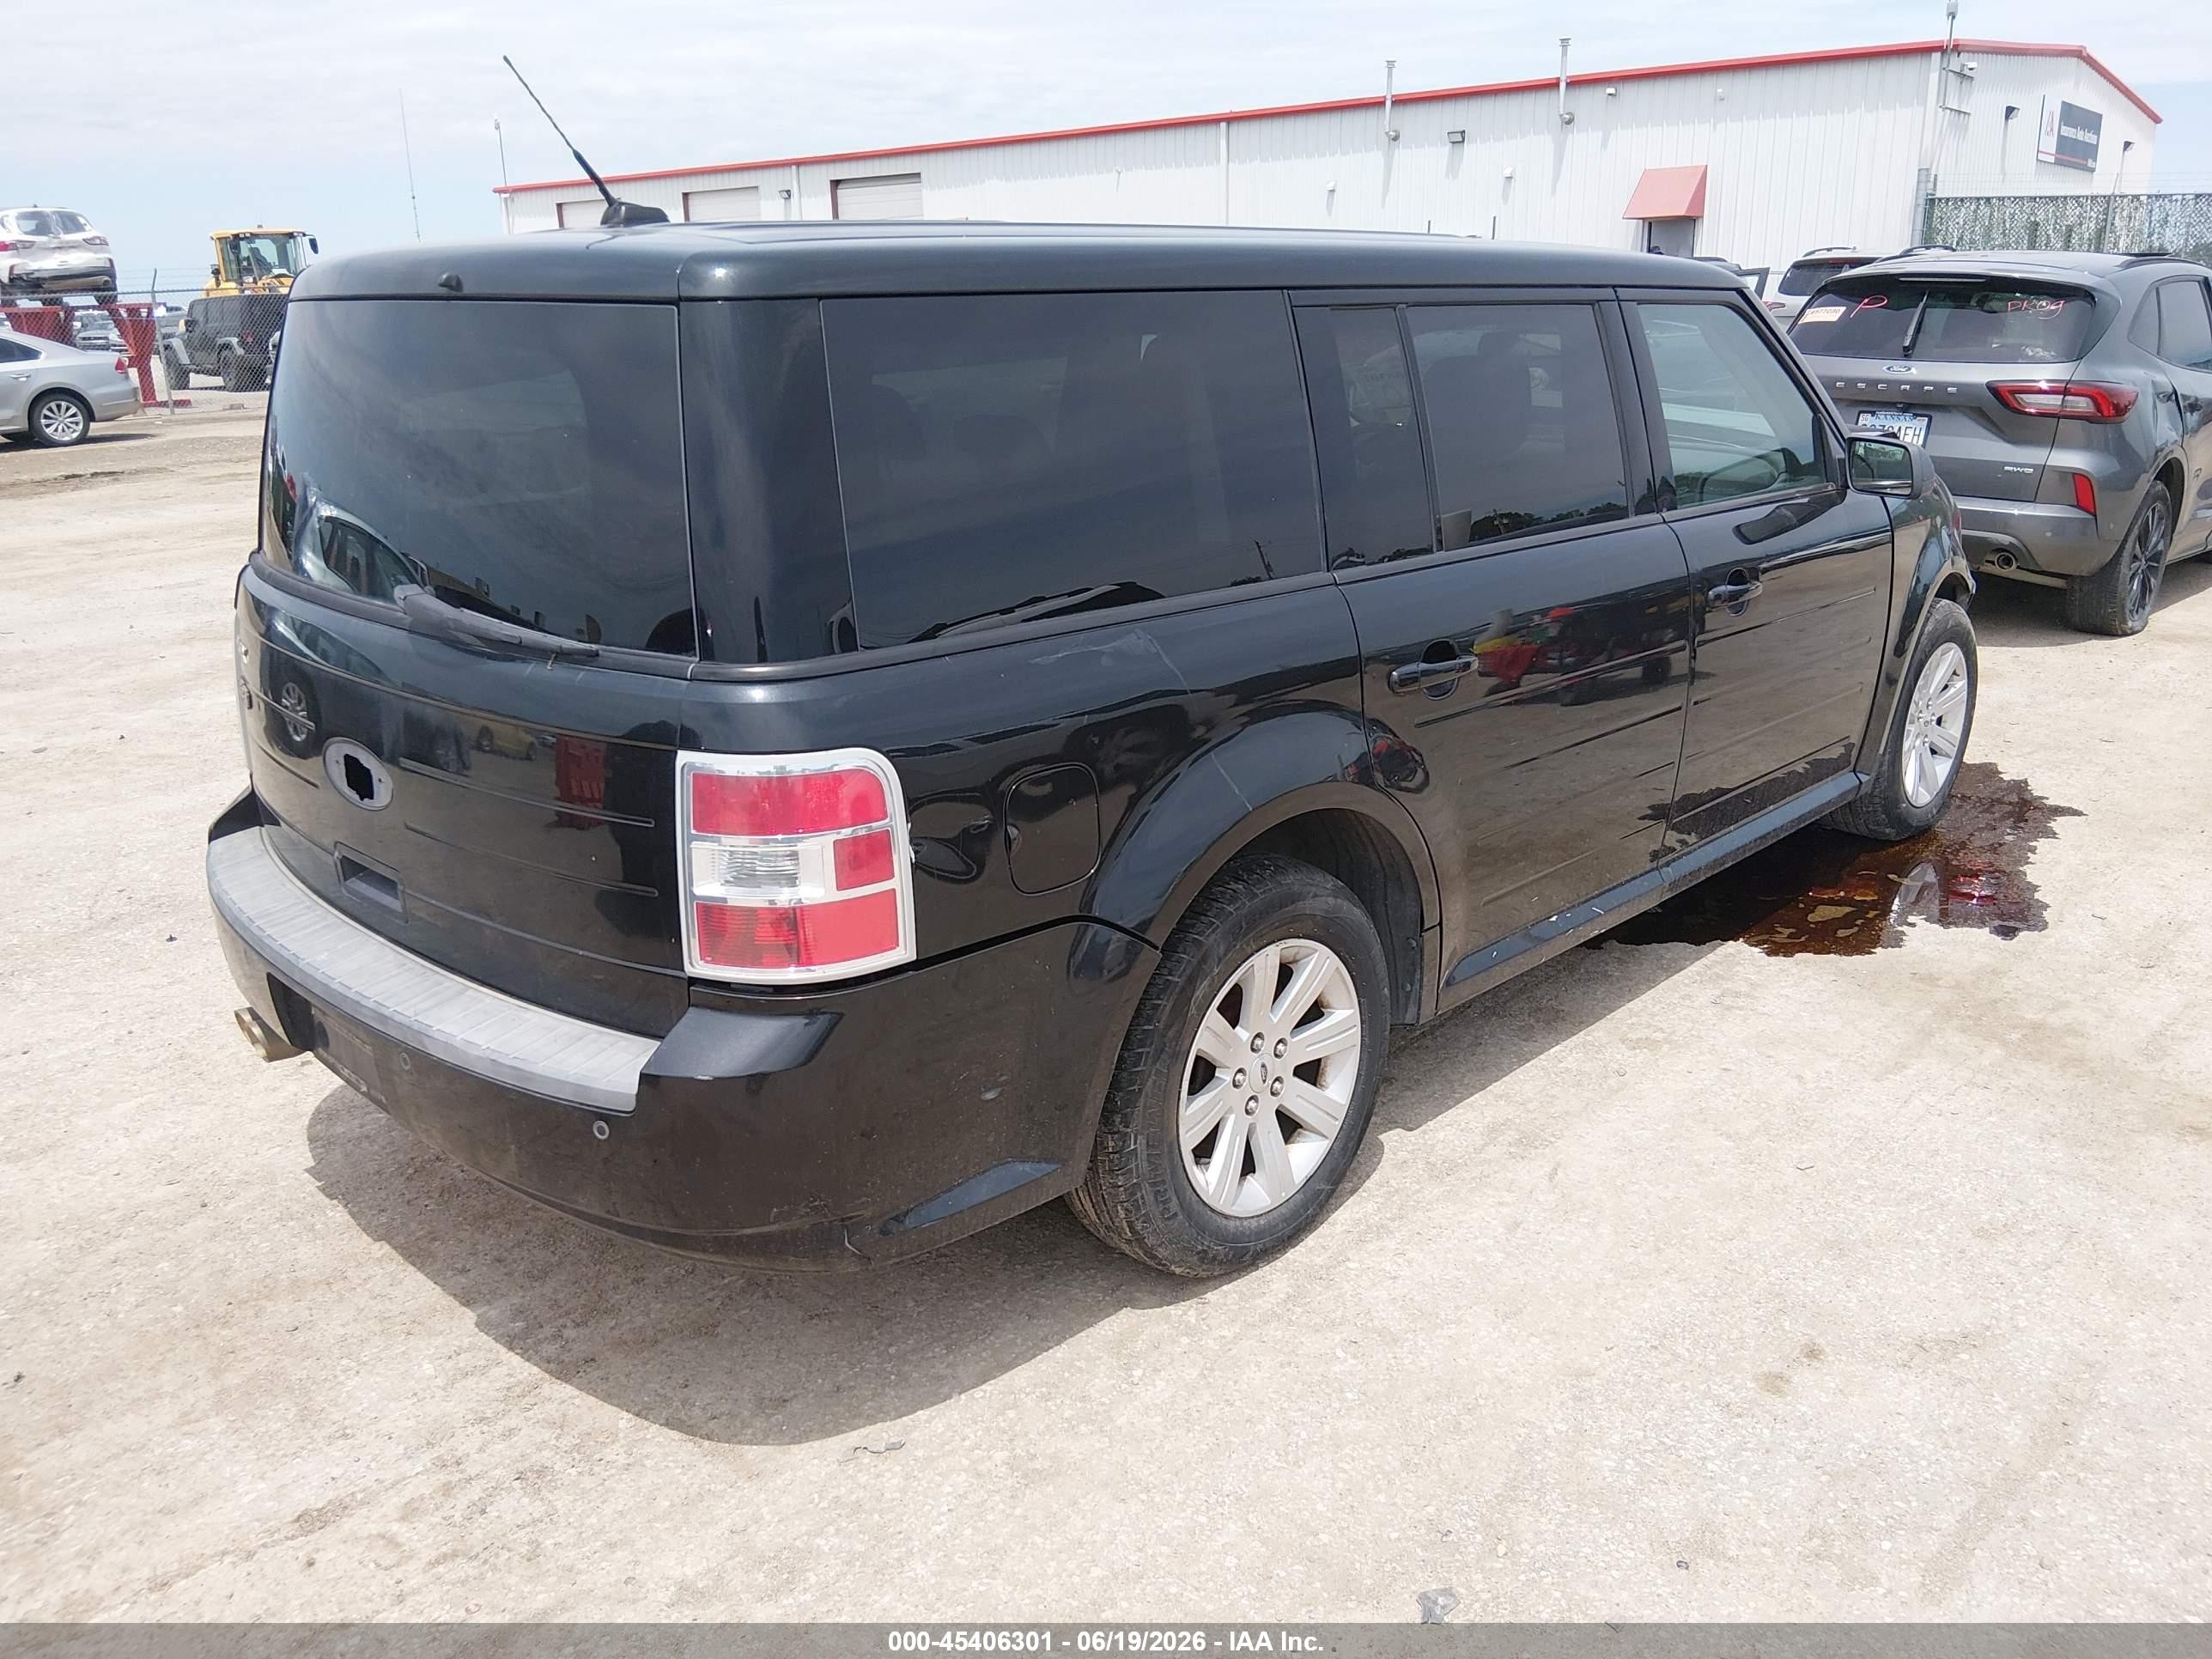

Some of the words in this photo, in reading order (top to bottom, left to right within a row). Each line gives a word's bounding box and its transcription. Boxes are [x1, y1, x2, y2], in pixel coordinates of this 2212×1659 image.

[1850, 295, 1888, 319] P
[1836, 381, 1958, 393] ESCAPE
[1875, 414, 1914, 422] KANSAS
